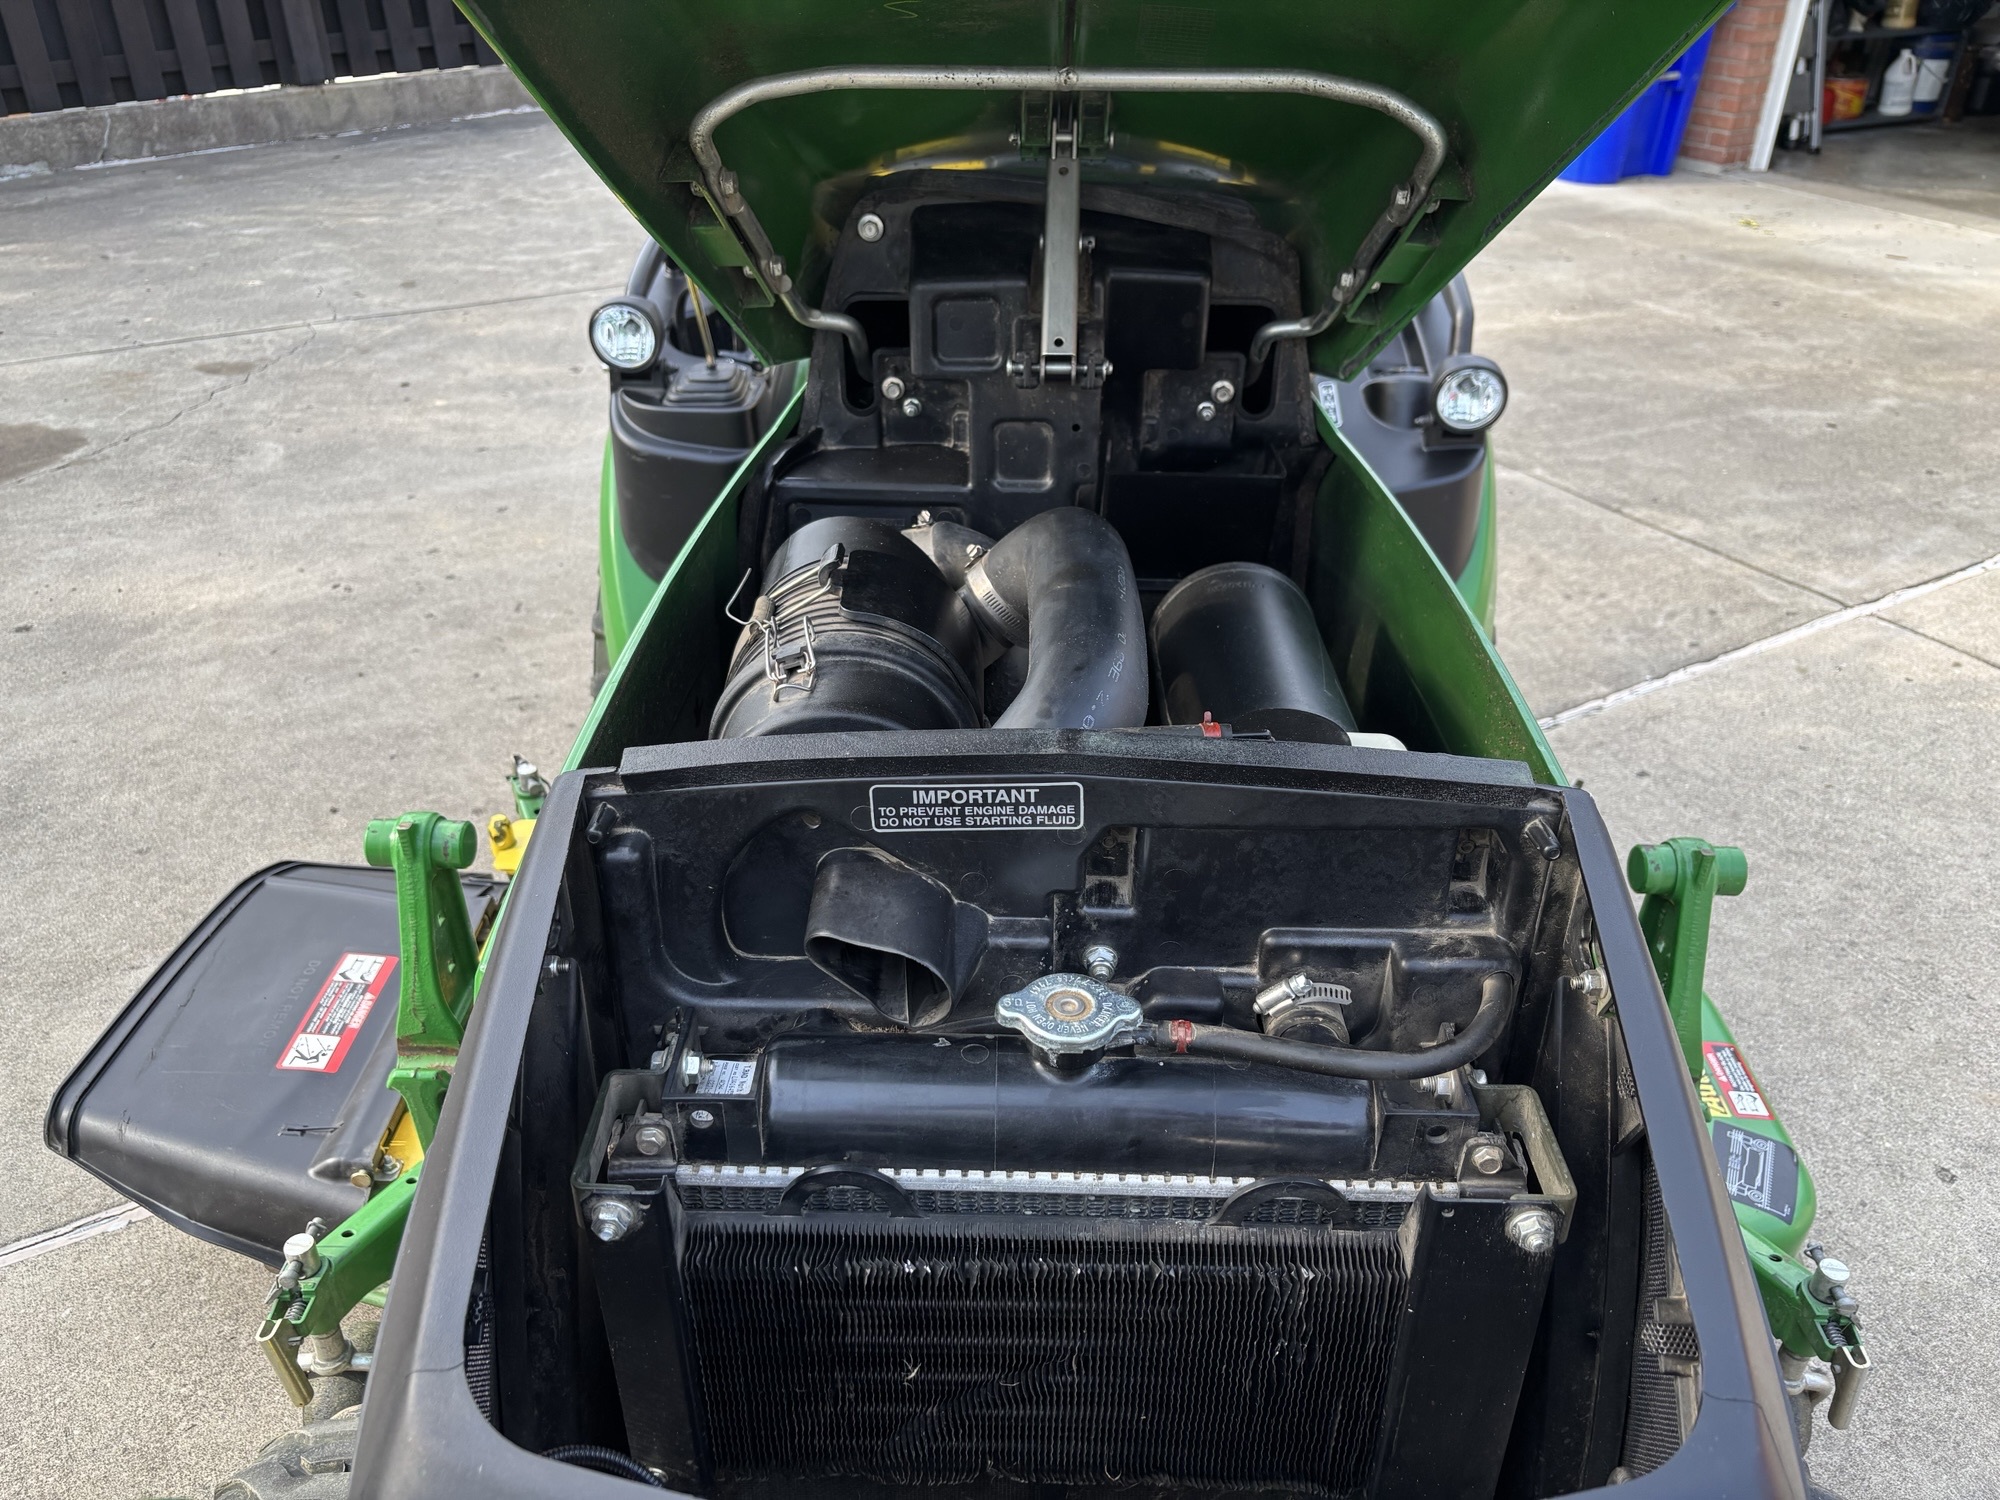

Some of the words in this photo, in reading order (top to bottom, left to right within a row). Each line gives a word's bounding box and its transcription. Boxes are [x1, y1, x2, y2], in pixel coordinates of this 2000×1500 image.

[912, 788, 1040, 805] IMPORTANT
[878, 807, 896, 817] TO
[900, 806, 962, 817] PREVENT
[964, 805, 1015, 815] ENGINE
[1018, 804, 1075, 815] DAMAGE
[879, 817, 899, 827] DO
[903, 817, 931, 827] NOT
[934, 816, 962, 826] USE
[965, 815, 1033, 826] STARTING
[1036, 814, 1076, 825] FLUID
[303, 959, 322, 975] DO
[287, 978, 310, 1001] NOT
[1032, 1013, 1055, 1030] OPEN
[1057, 1023, 1089, 1034] NEVER
